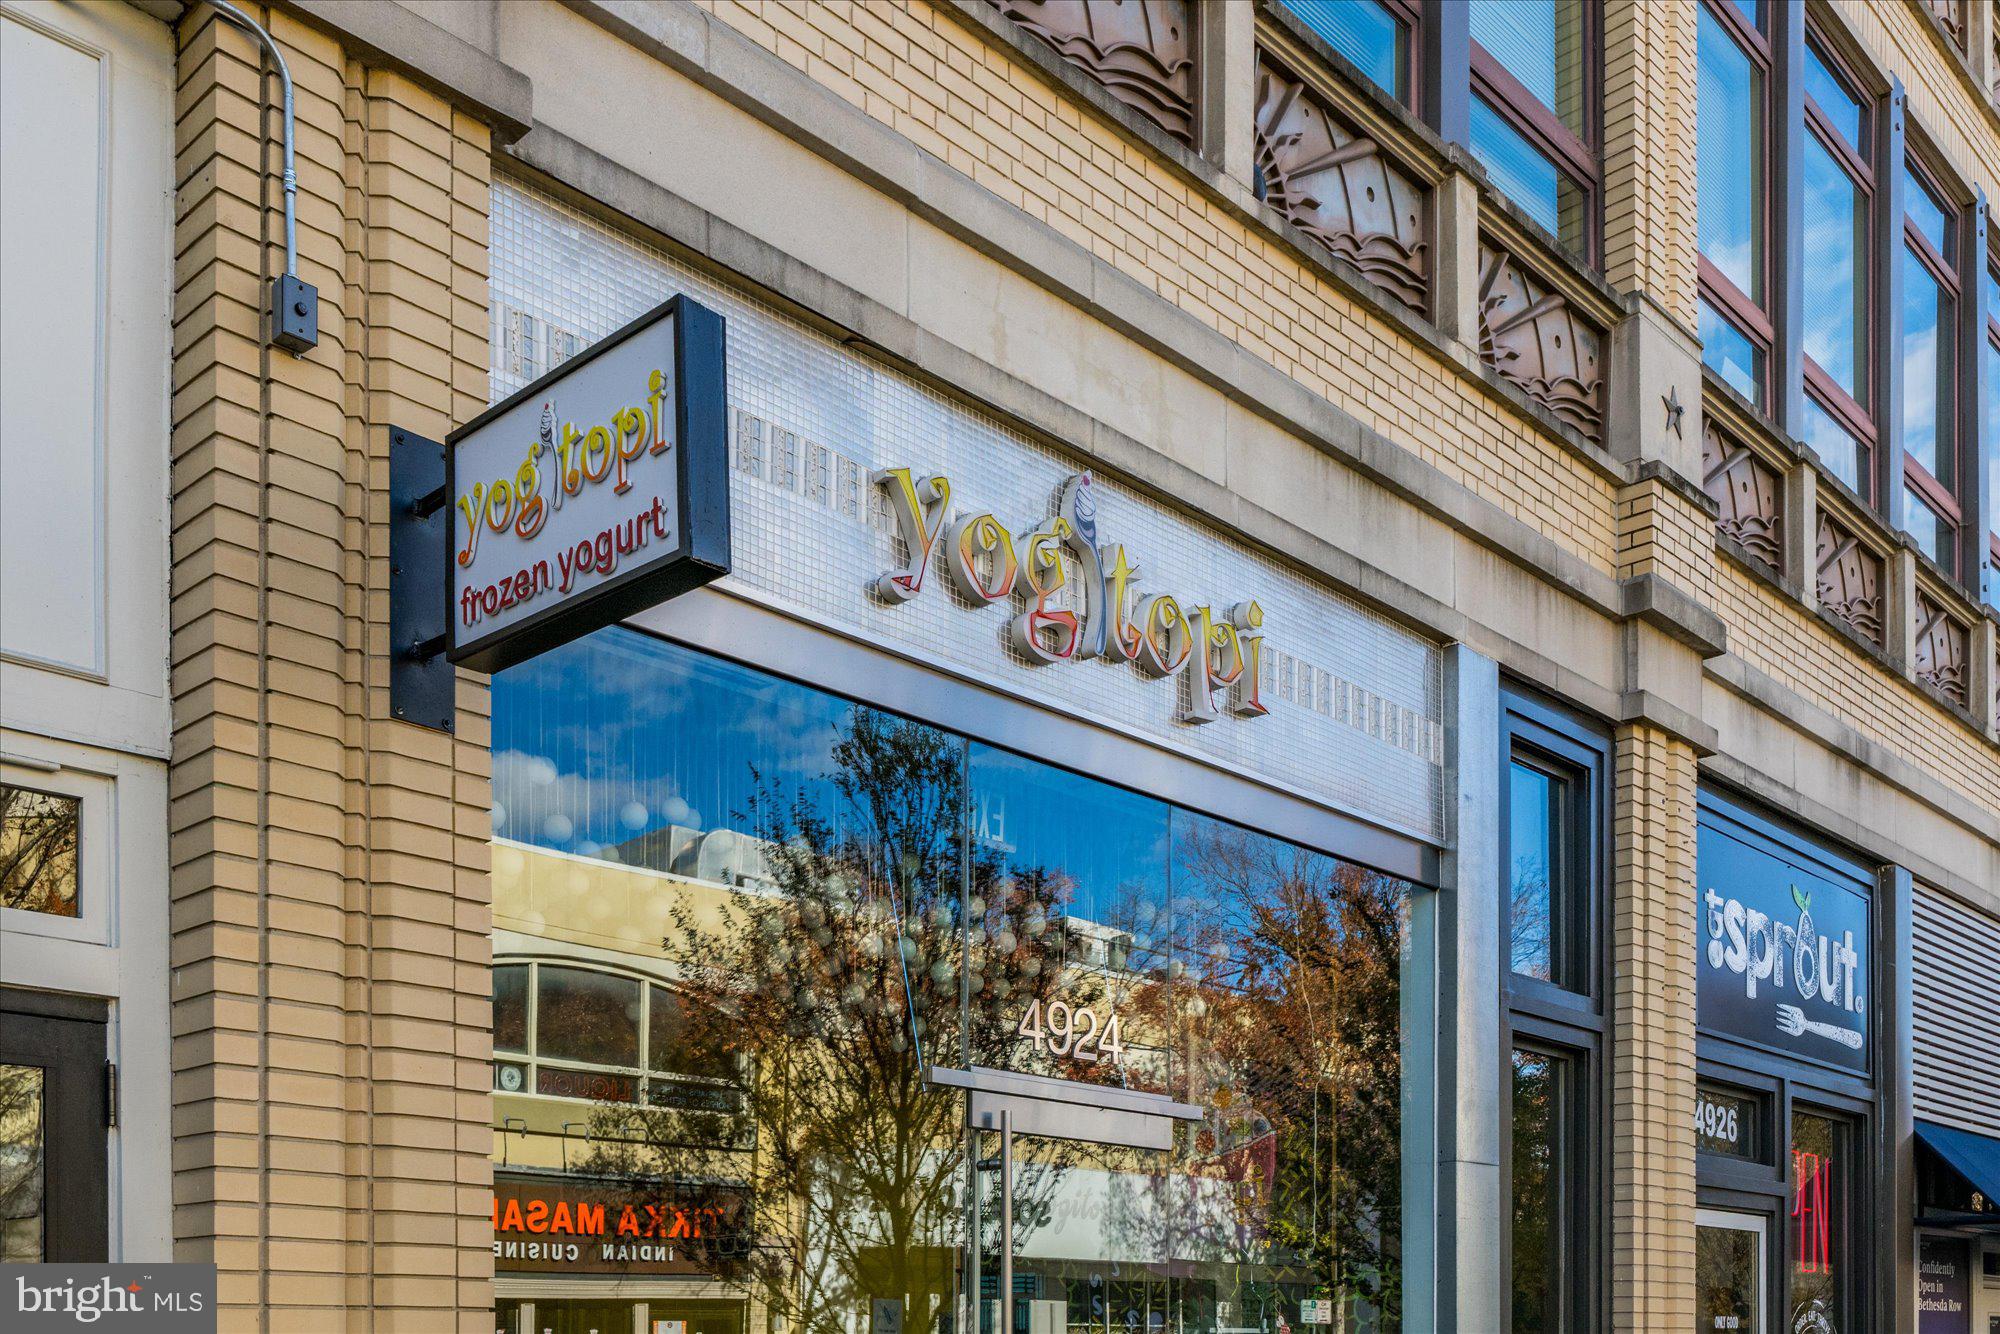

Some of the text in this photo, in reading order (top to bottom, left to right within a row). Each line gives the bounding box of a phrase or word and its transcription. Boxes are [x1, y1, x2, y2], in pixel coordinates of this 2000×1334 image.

[461, 496, 670, 627] frozen yogurt
[1018, 999, 1124, 1064] 4924
[1695, 1100, 1738, 1142] 4926
[1919, 1260, 1955, 1278] Confidently
[1919, 1279, 1944, 1295] Open in
[1919, 1298, 1962, 1312] Bethesda Row
